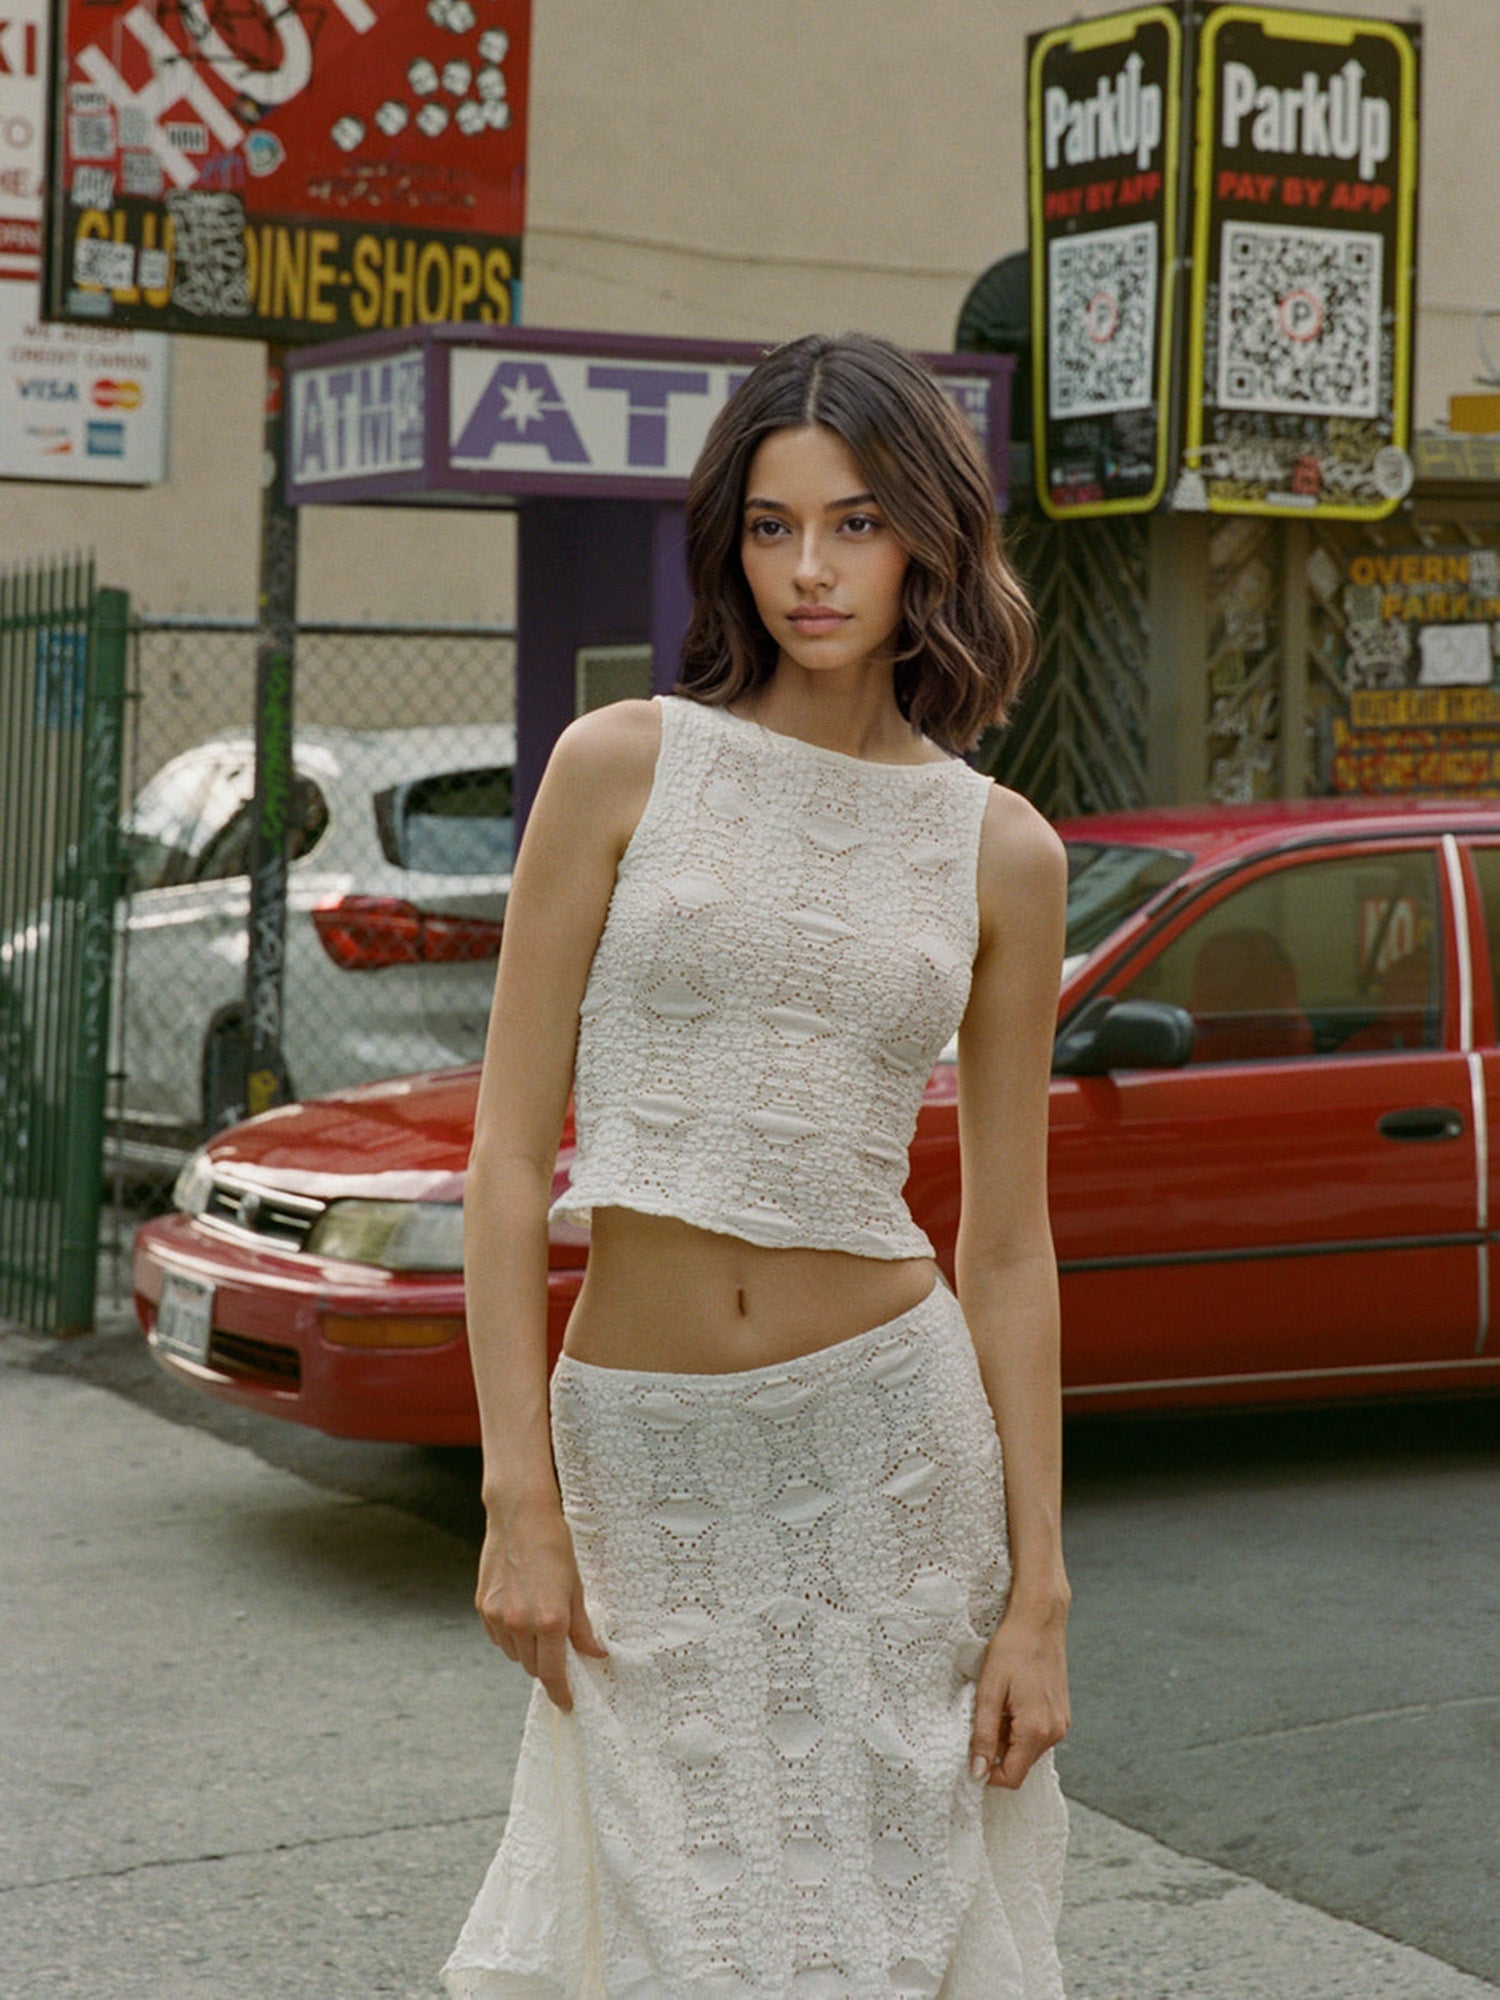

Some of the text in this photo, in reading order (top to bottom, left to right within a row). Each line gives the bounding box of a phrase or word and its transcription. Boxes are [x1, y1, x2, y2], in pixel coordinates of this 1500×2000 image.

[1044, 52, 1162, 170] ParkUp
[1221, 59, 1391, 181] ParkUp
[1044, 171, 1162, 221] PAY BY APP
[1218, 170, 1391, 214] PAY BY APP
[16, 376, 79, 399] VISA
[453, 361, 753, 468] AT
[1350, 555, 1470, 587] OVERN
